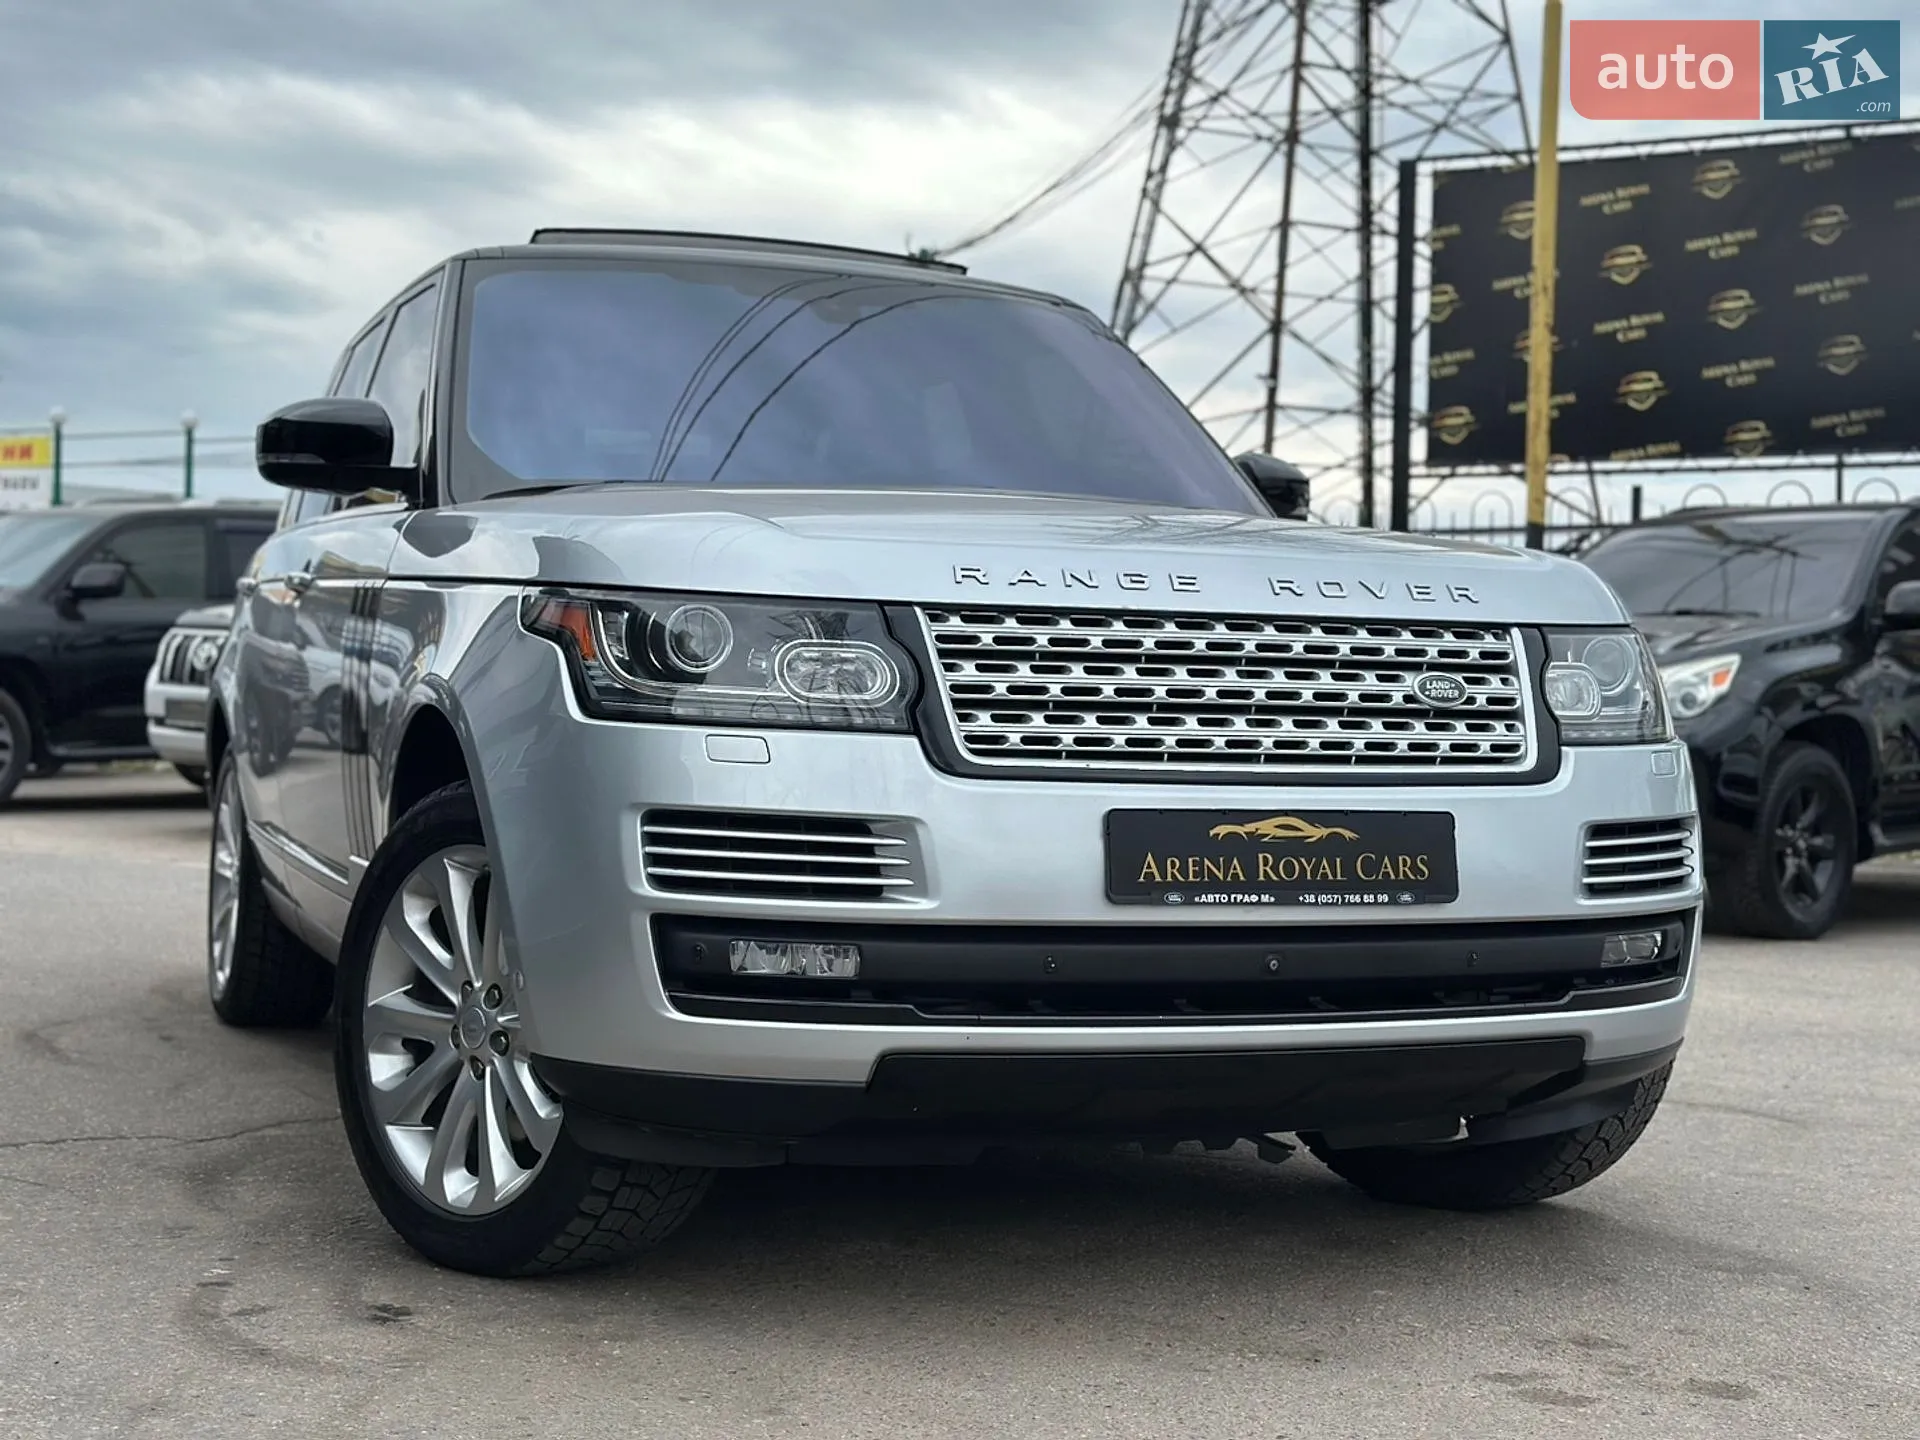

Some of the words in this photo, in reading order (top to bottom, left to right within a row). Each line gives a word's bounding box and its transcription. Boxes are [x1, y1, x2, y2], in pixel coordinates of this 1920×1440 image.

[952, 564, 1201, 594] RANGE
[1267, 575, 1480, 604] ROVER
[1426, 680, 1450, 689] LAND
[1430, 689, 1459, 698] ROVER
